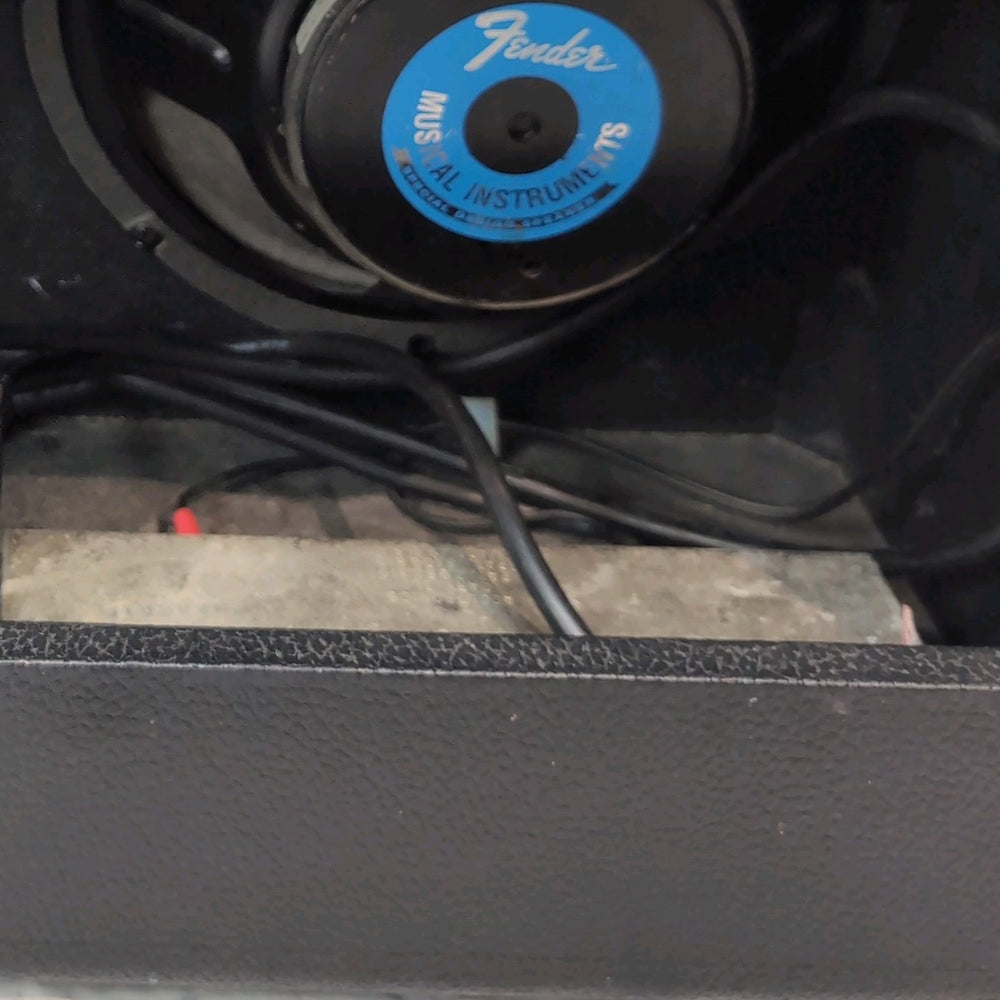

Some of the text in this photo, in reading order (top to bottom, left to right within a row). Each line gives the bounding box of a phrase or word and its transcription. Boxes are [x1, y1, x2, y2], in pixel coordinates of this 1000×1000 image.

[463, 9, 618, 72] Fender
[413, 89, 631, 210] MUSICAL INSTRUMENTS
